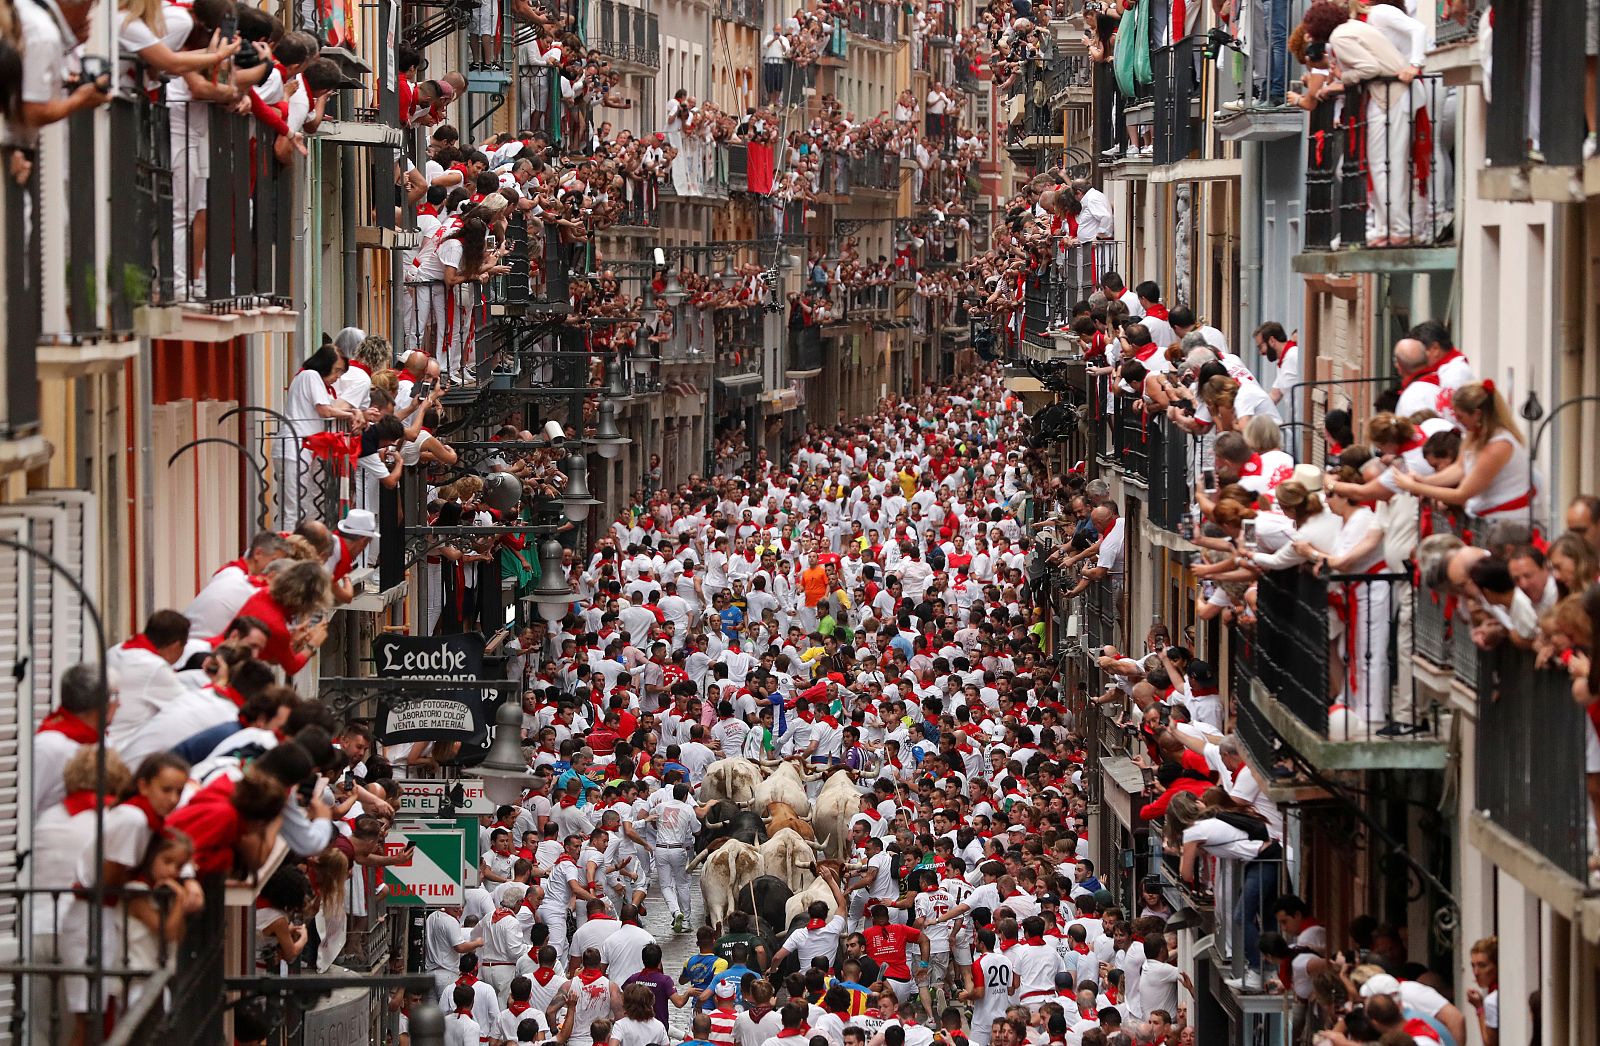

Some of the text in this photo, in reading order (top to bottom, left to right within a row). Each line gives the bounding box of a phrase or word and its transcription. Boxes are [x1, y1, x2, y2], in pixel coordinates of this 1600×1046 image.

[383, 642, 467, 673] Leache
[422, 700, 468, 714] FOTOGRAFICO
[397, 709, 465, 721] LABORATORIO COLOR
[393, 719, 466, 730] VENTA DE MATERIAL
[401, 798, 416, 808] EN
[421, 798, 434, 808] EL
[388, 883, 454, 896] UJIFILM
[988, 964, 1010, 988] 20
